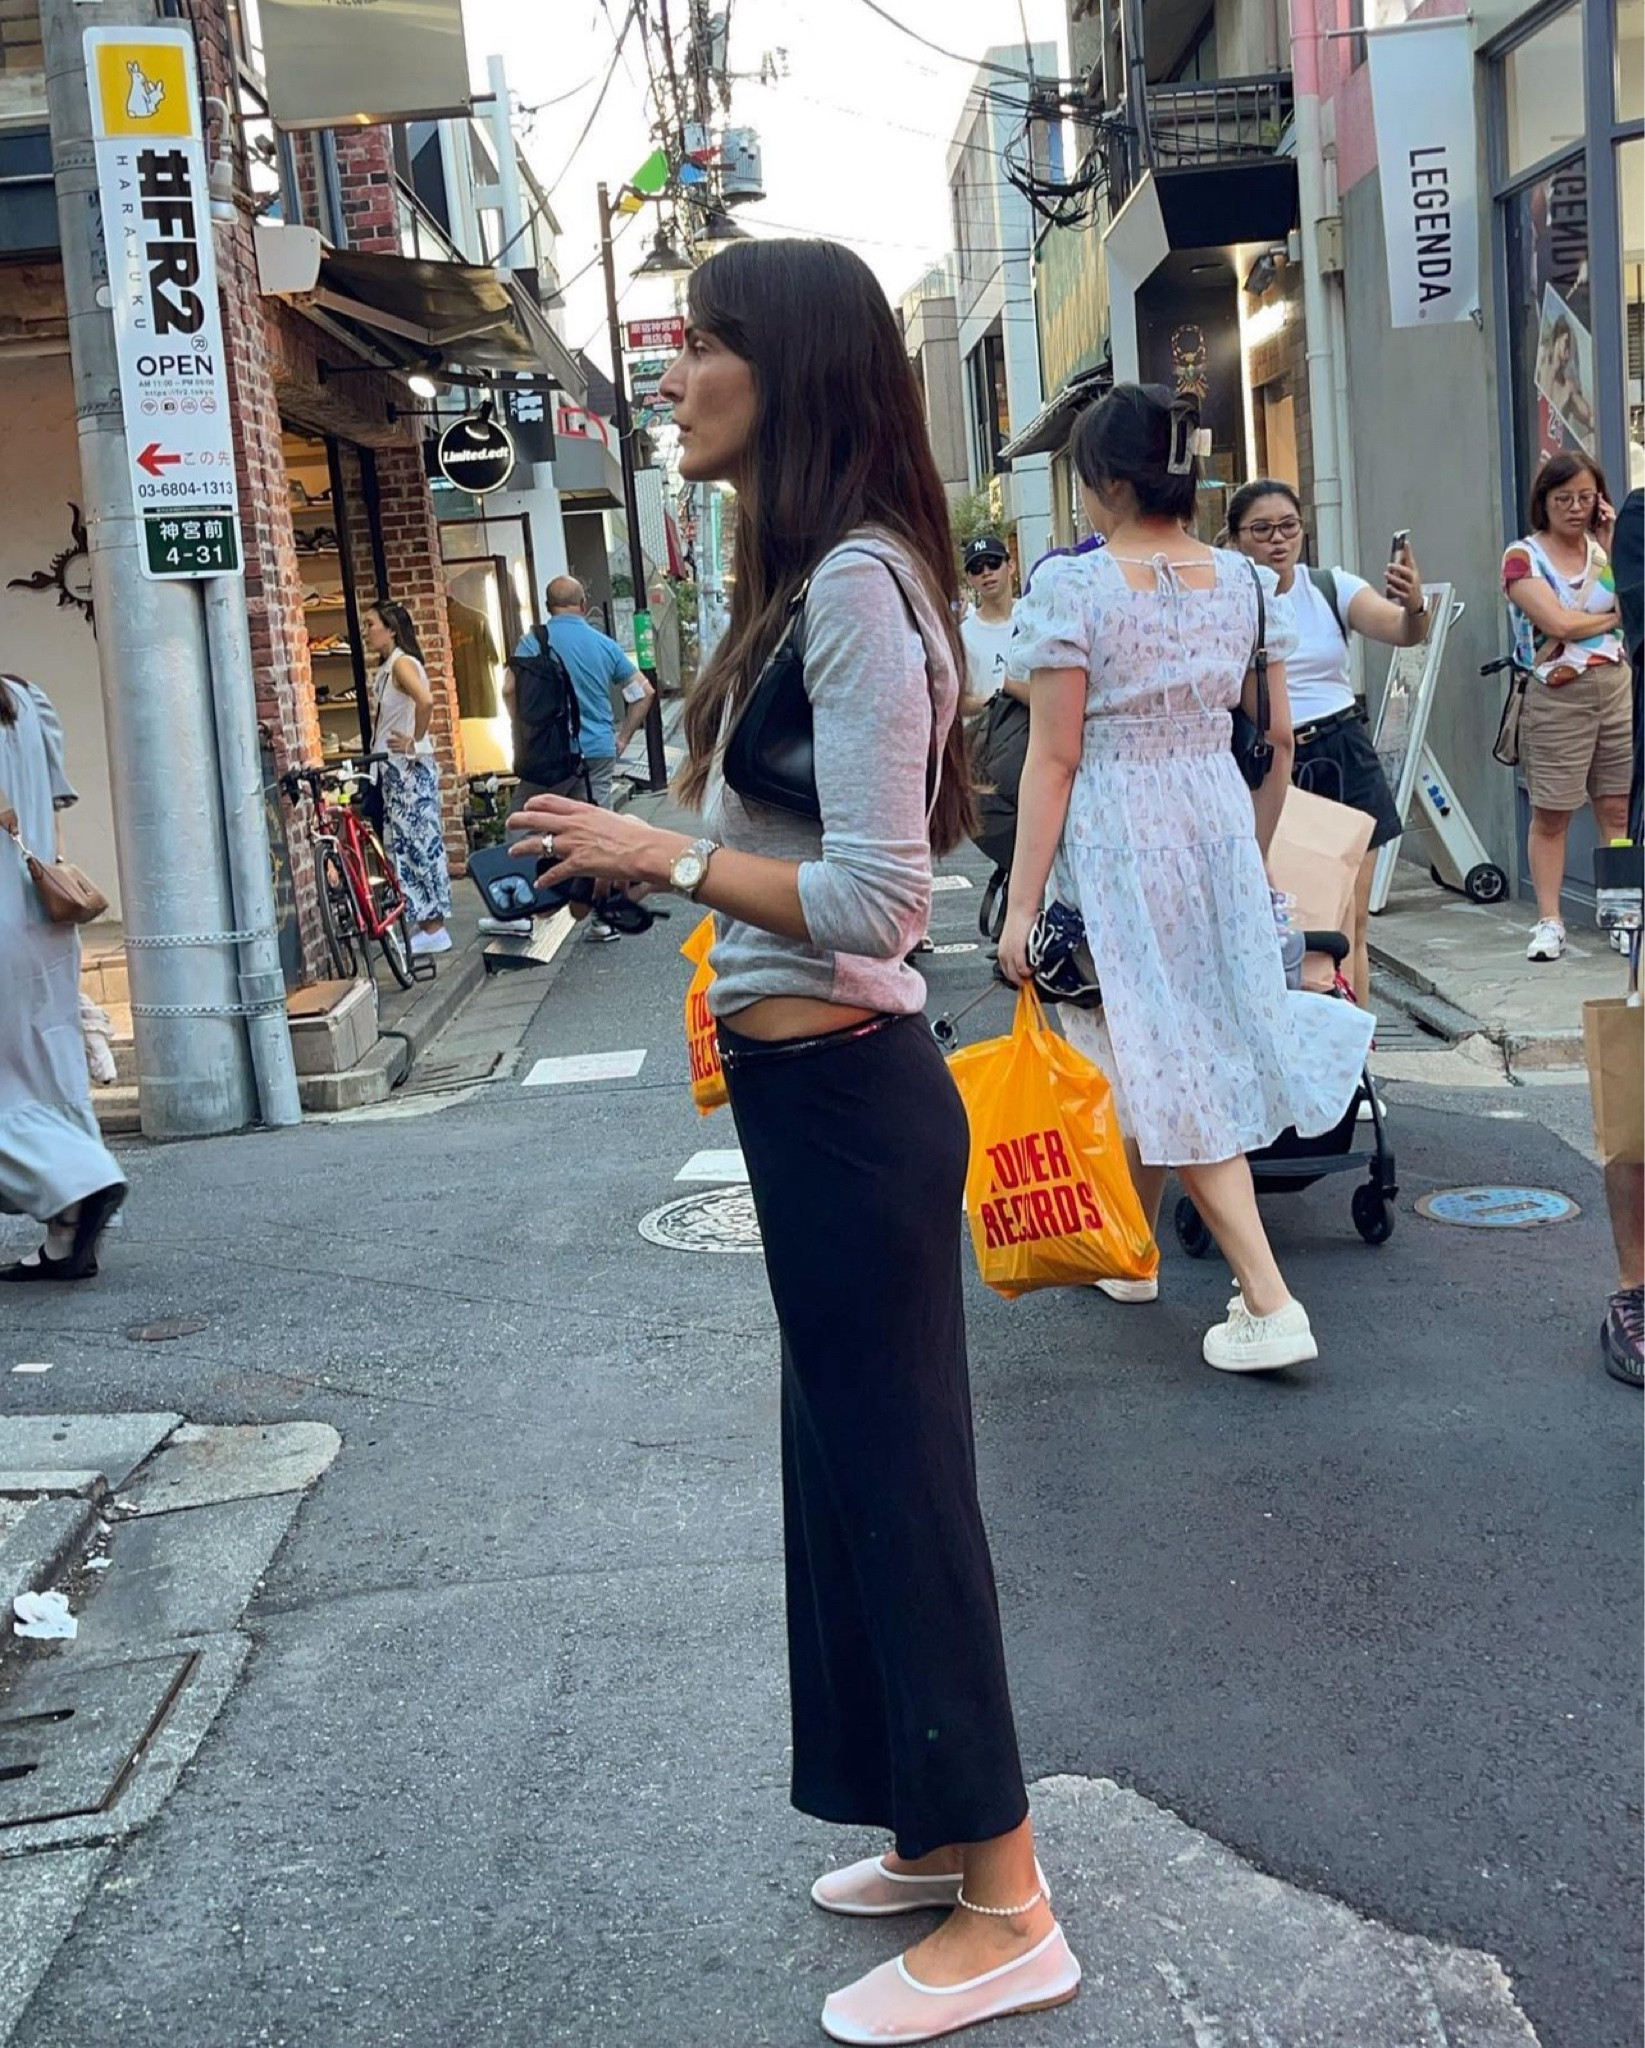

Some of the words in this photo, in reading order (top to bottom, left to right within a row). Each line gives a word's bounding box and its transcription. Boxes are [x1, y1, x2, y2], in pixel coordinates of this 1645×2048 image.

[1409, 146, 1451, 304] LEGENDA
[116, 155, 147, 329] HARAJUKU
[136, 148, 205, 335] #FR2
[136, 355, 214, 377] OPEN
[138, 380, 151, 388] AM
[182, 379, 193, 387] PM
[183, 451, 232, 466] この先
[138, 481, 234, 498] 03-6804-1313
[159, 519, 224, 542] 神宮前
[165, 543, 224, 566] 4-31
